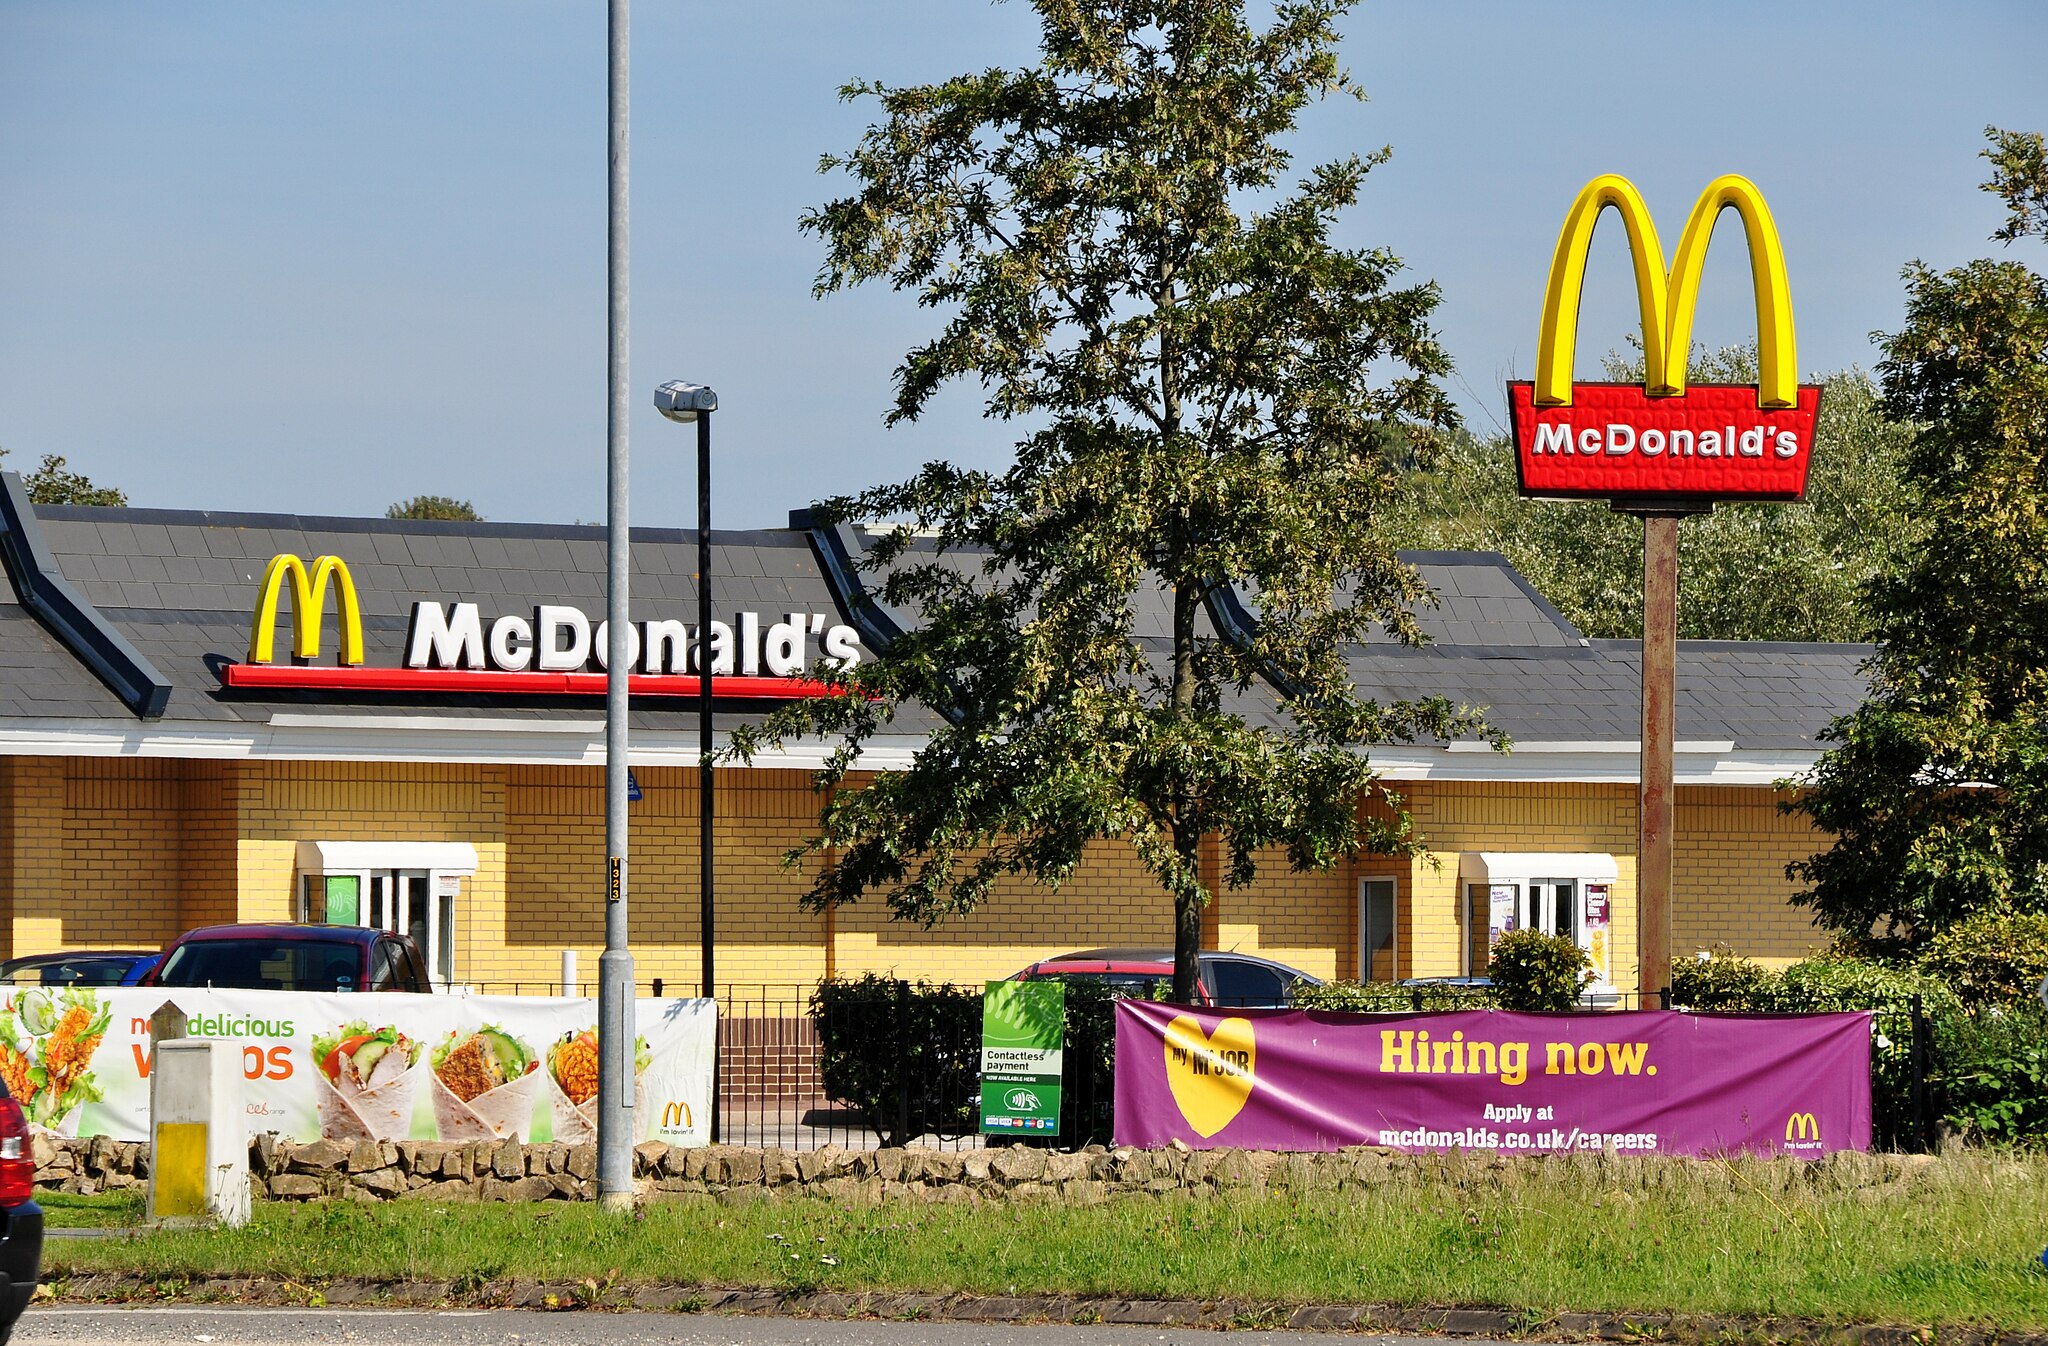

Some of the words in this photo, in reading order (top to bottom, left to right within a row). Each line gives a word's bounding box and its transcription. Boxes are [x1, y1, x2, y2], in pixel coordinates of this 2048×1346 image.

[1533, 422, 1798, 458] McDonald's
[407, 601, 861, 677] McDonald's
[187, 1013, 295, 1037] delicious
[987, 1050, 1044, 1061] Contactless
[987, 1062, 1029, 1071] payment
[1379, 1030, 1529, 1086] Hiring
[1545, 1042, 1657, 1076] now.
[1483, 1103, 1532, 1123] Apply
[1536, 1105, 1553, 1120] at
[1379, 1127, 1657, 1150] mcdonalds.co.uk/careers
